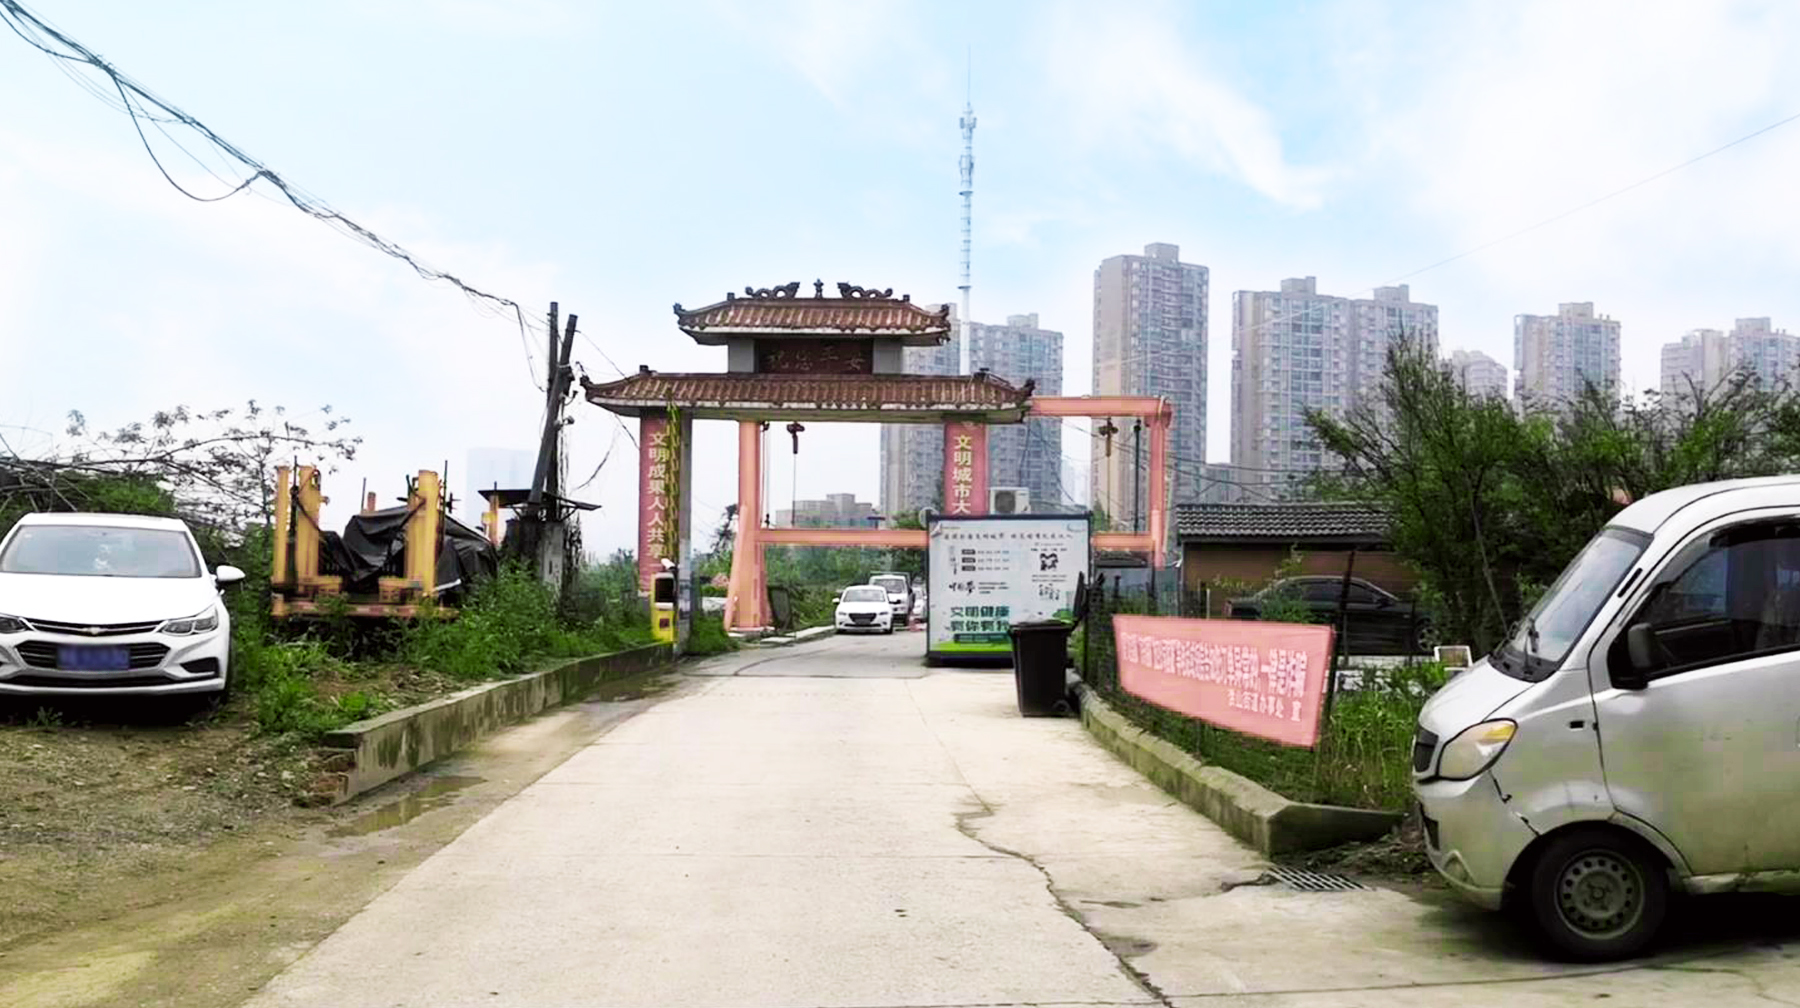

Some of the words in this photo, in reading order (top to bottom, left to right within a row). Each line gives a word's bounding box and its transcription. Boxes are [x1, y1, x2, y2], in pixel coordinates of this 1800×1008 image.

[647, 431, 670, 559] 文明成果人人共享
[951, 435, 973, 514] 文明城市大
[950, 605, 1010, 618] 文明健康
